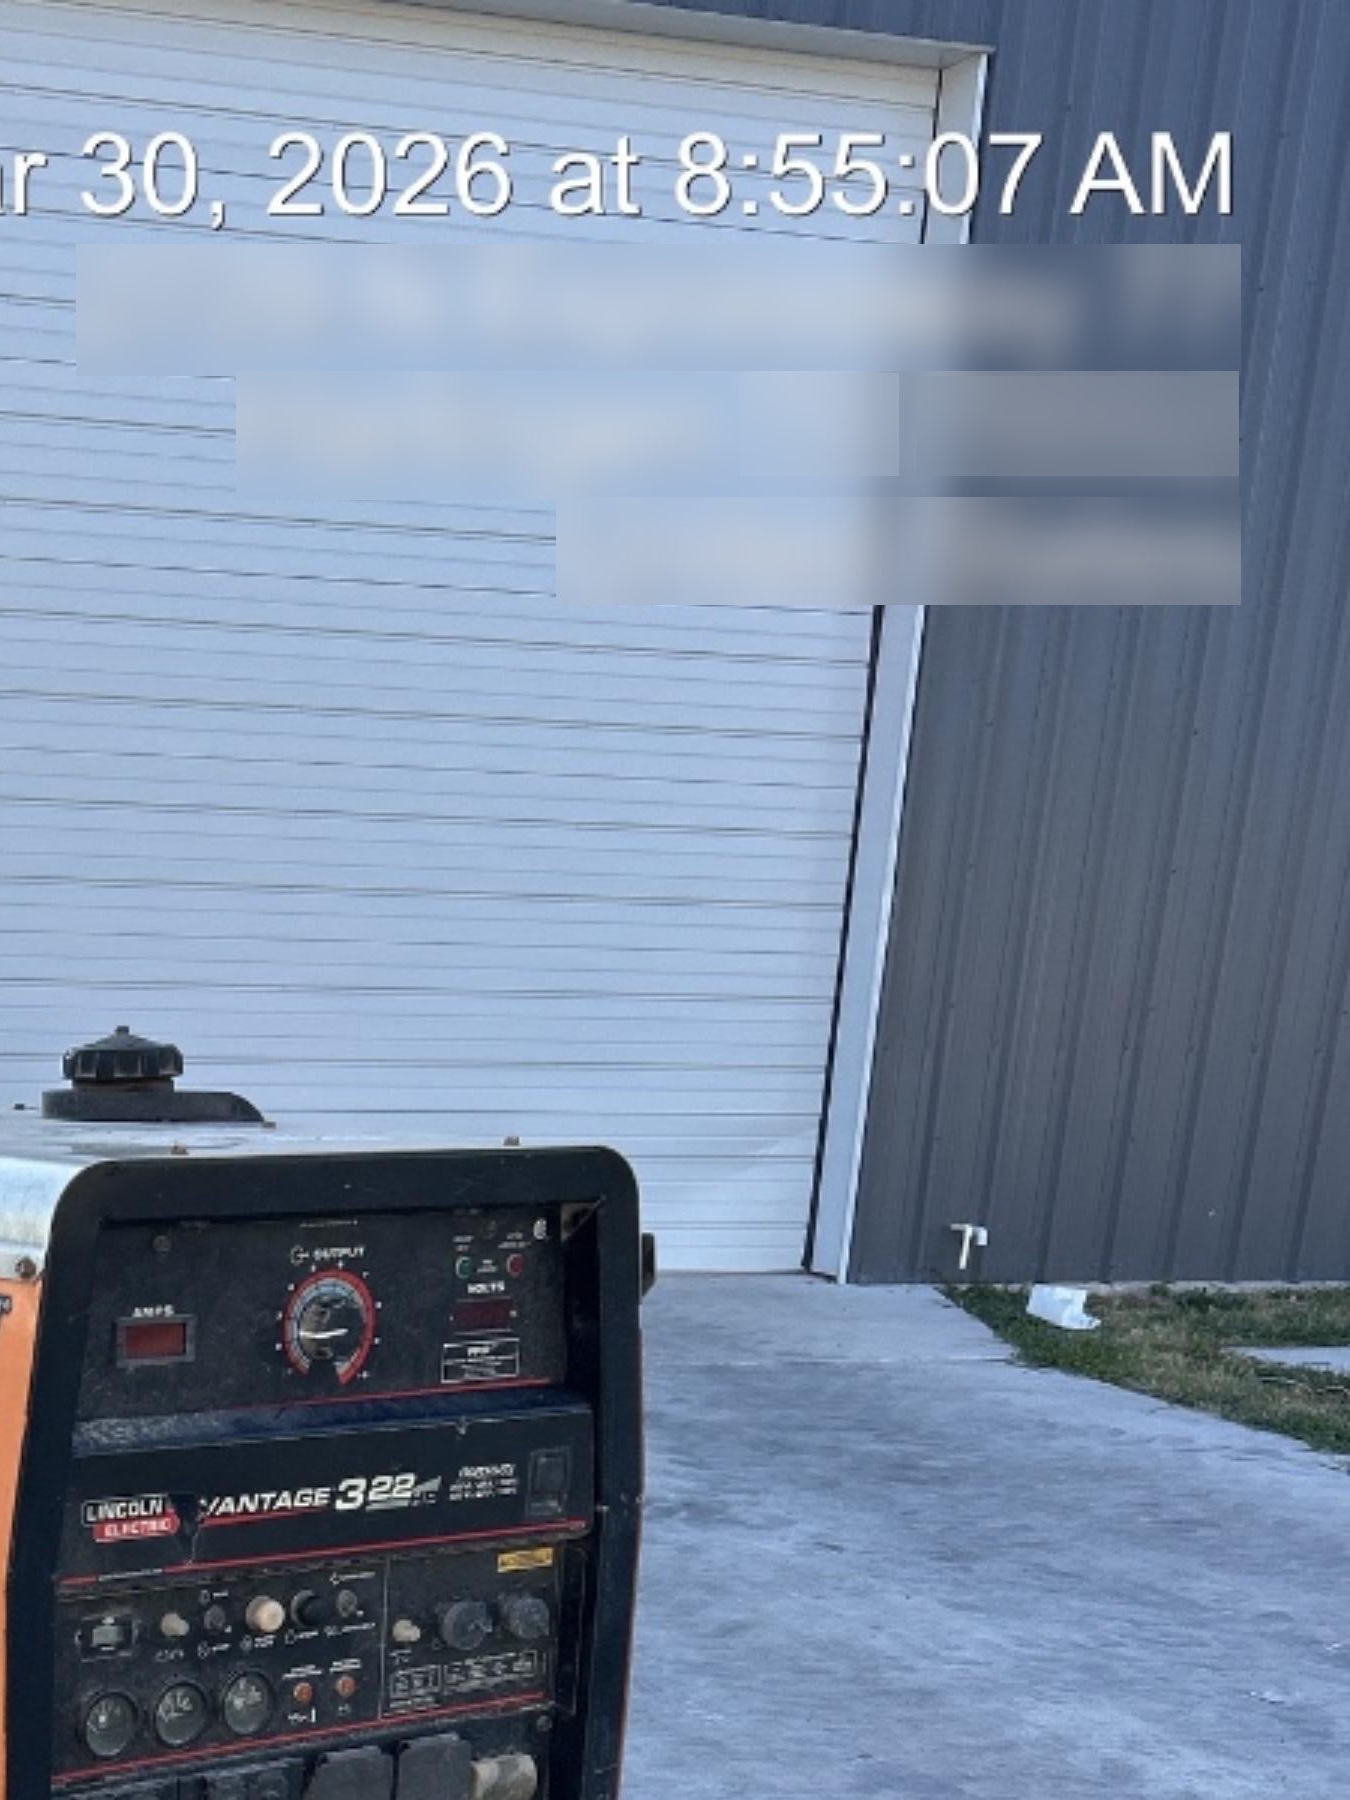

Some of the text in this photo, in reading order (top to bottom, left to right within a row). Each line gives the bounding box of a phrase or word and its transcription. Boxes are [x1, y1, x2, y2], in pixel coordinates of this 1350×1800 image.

[313, 1246, 366, 1261] OUTPUT
[335, 1472, 416, 1511] 322
[86, 1499, 163, 1522] LINCOLN
